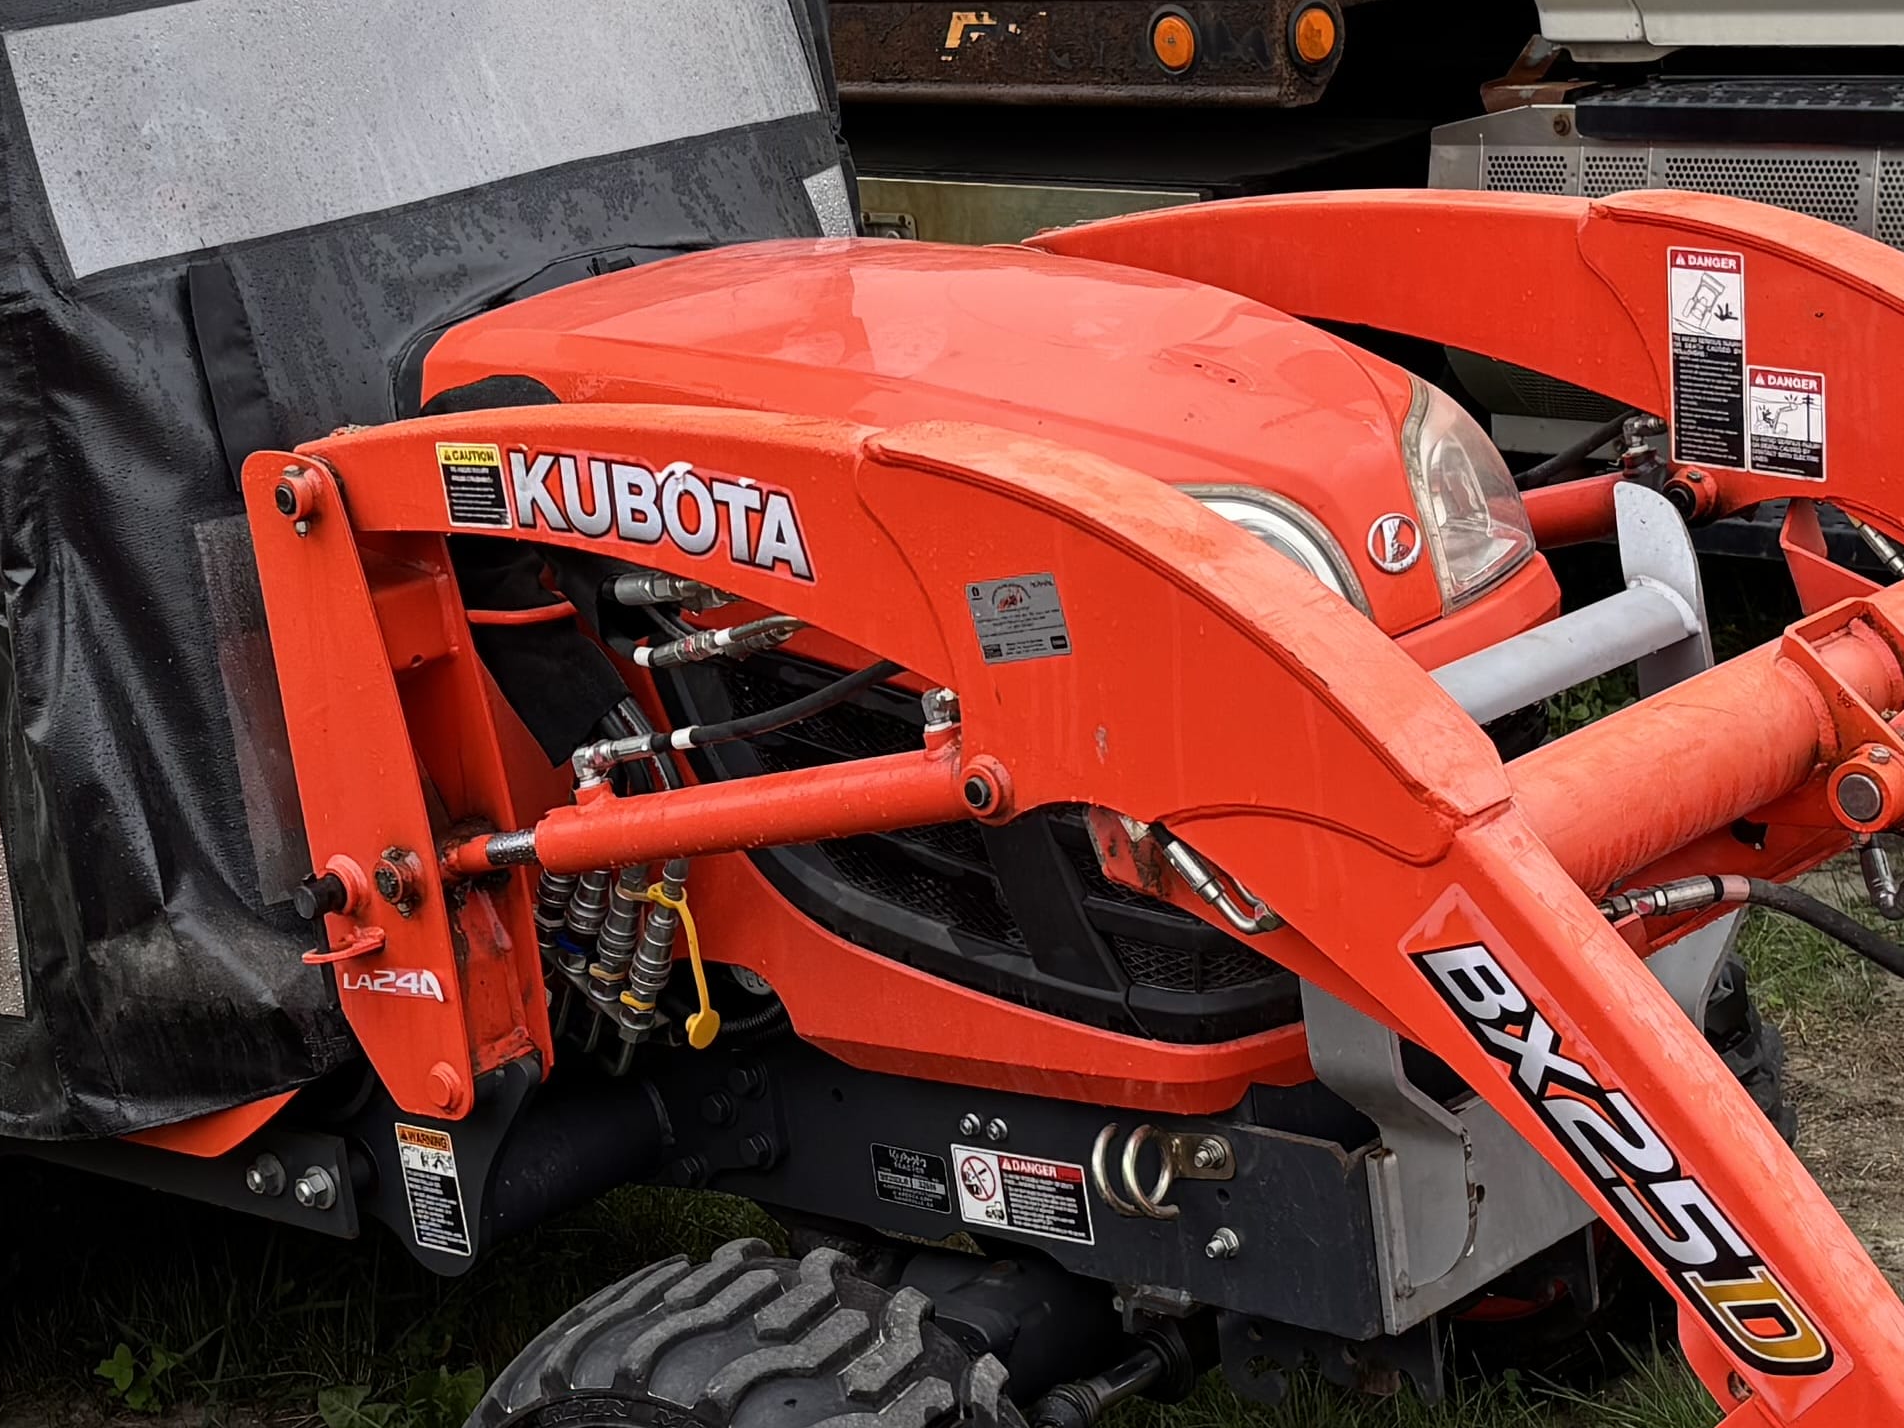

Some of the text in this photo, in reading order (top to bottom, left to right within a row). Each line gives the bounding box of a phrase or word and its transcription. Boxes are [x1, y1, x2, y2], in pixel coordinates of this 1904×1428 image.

[1687, 254, 1737, 270] DANGER
[1768, 374, 1817, 390] DANGER
[452, 450, 494, 462] CAUTION
[508, 448, 814, 582] KUBOTA
[406, 1130, 447, 1148] WARNING
[1414, 942, 1832, 1372] BX25D
[1012, 1160, 1057, 1178] DANGER
